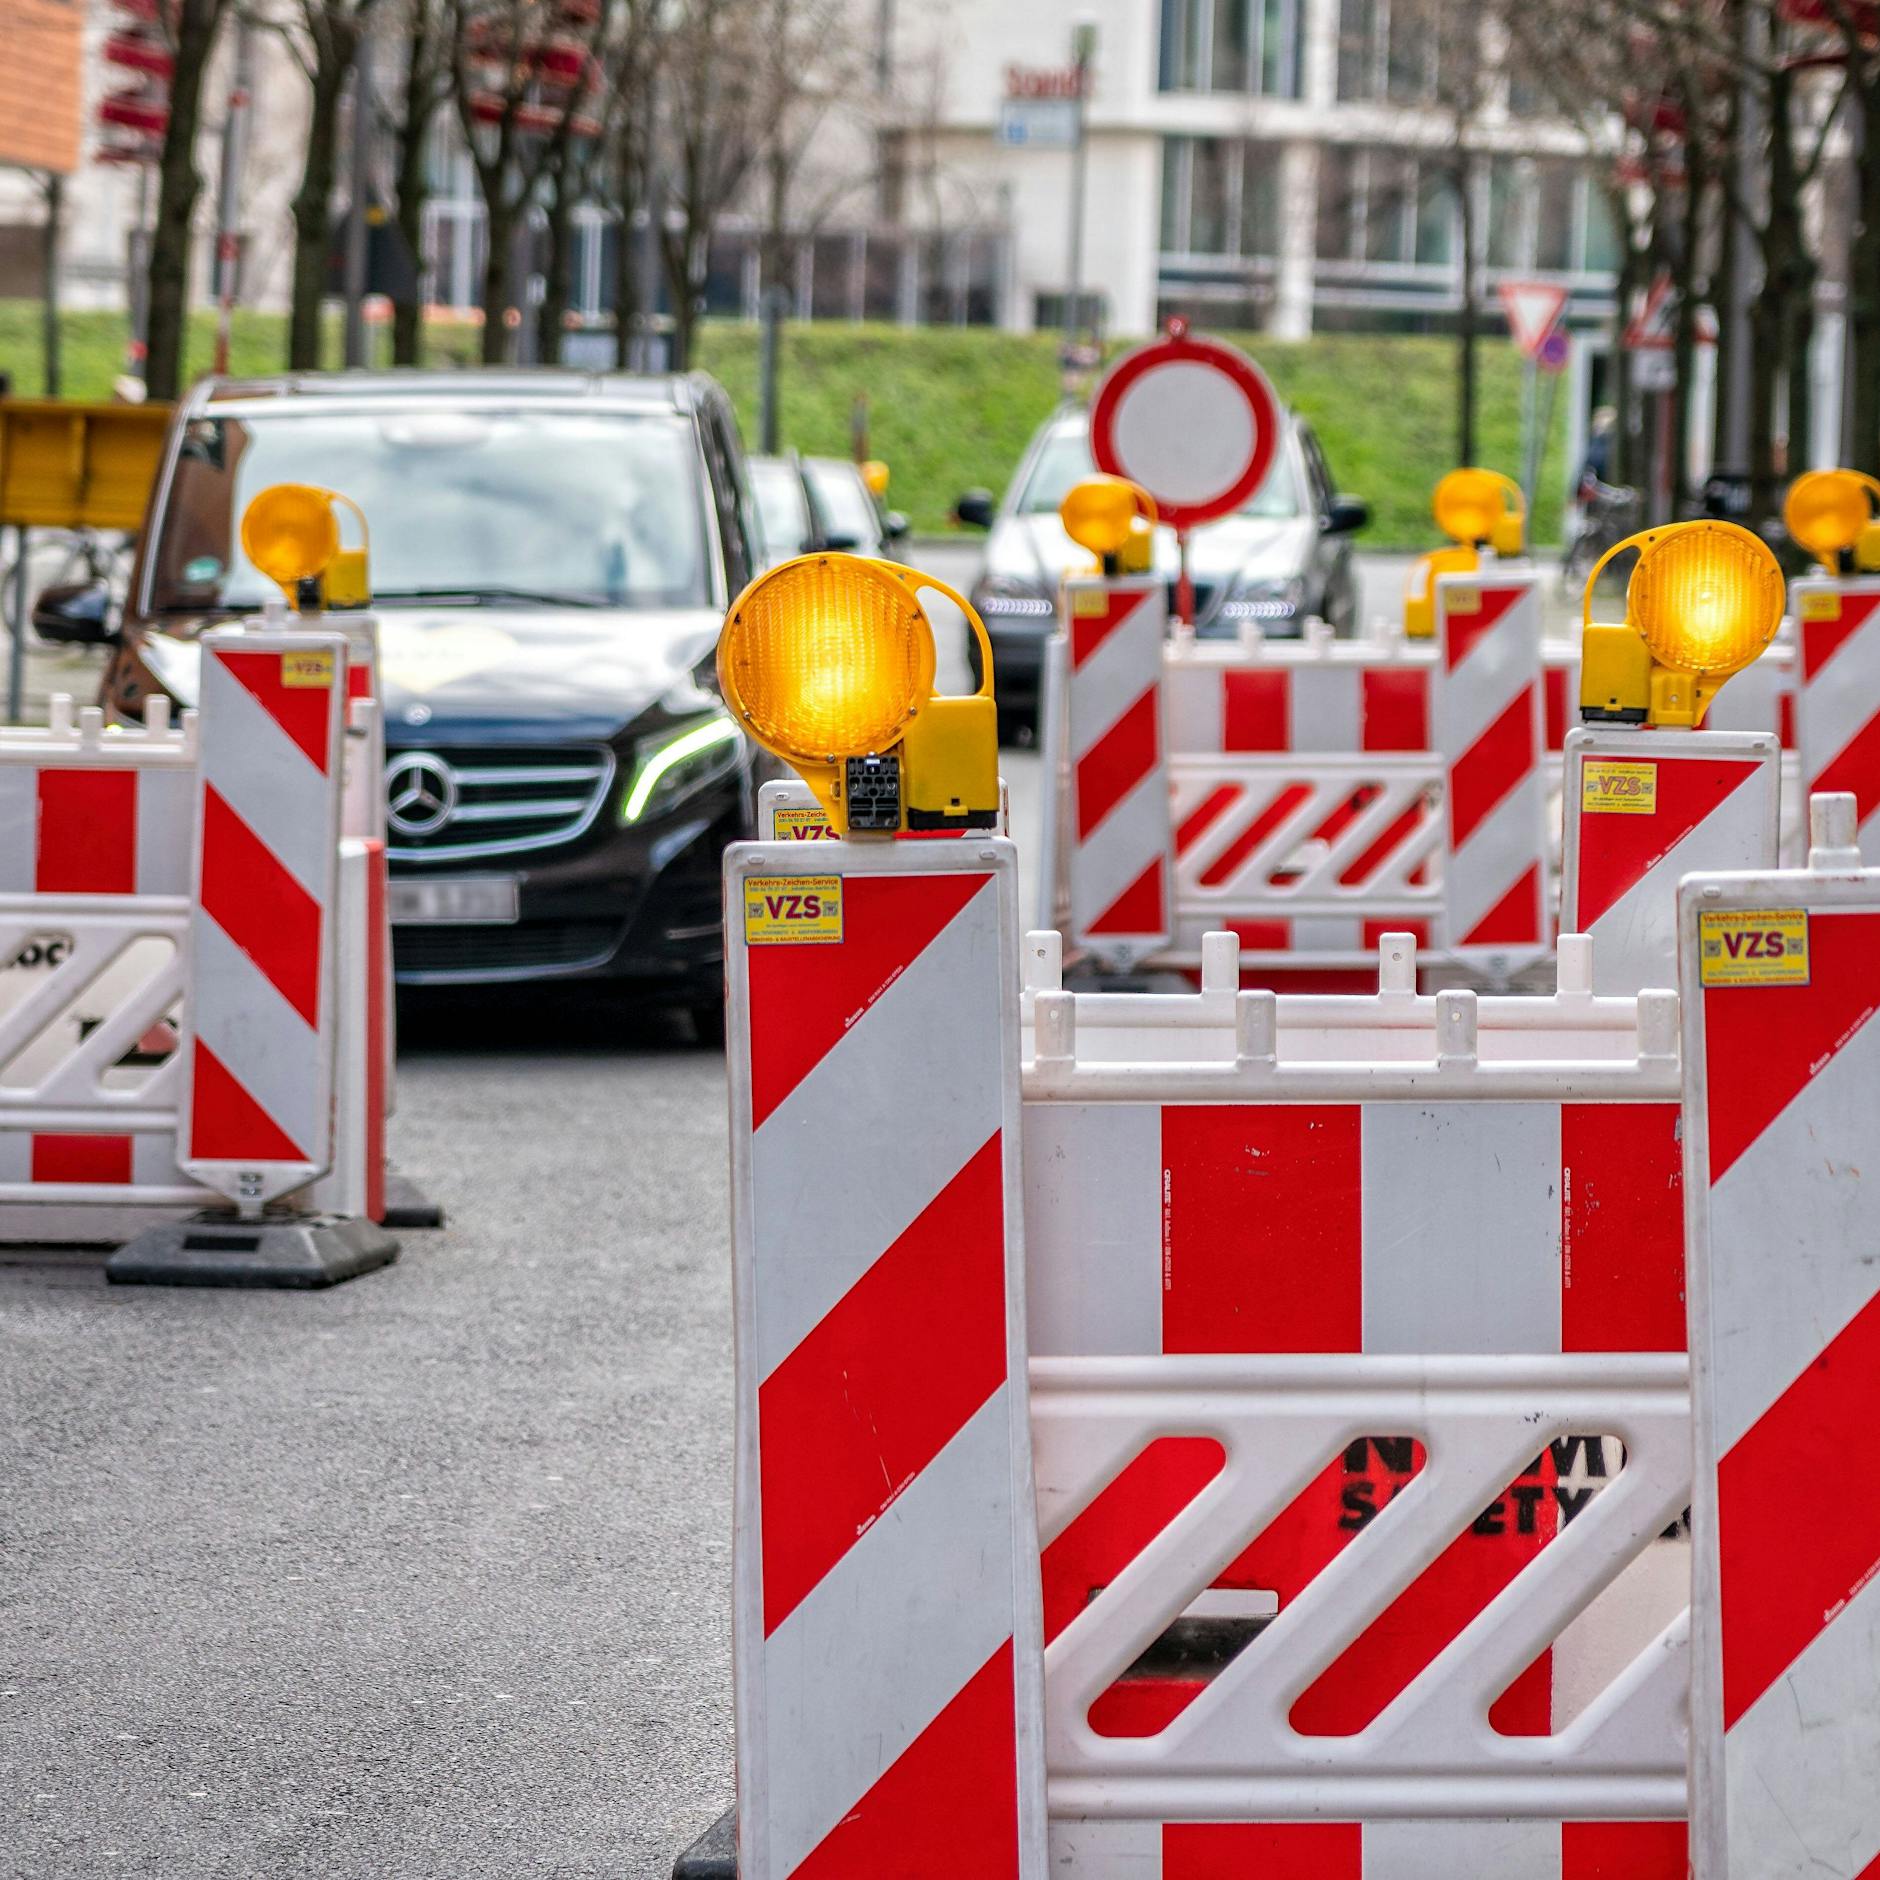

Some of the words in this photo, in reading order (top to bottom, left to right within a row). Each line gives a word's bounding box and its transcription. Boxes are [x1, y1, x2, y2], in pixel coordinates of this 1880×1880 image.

[1598, 775, 1641, 796] VZS
[765, 894, 821, 919] VZS
[1723, 931, 1785, 959] VZS
